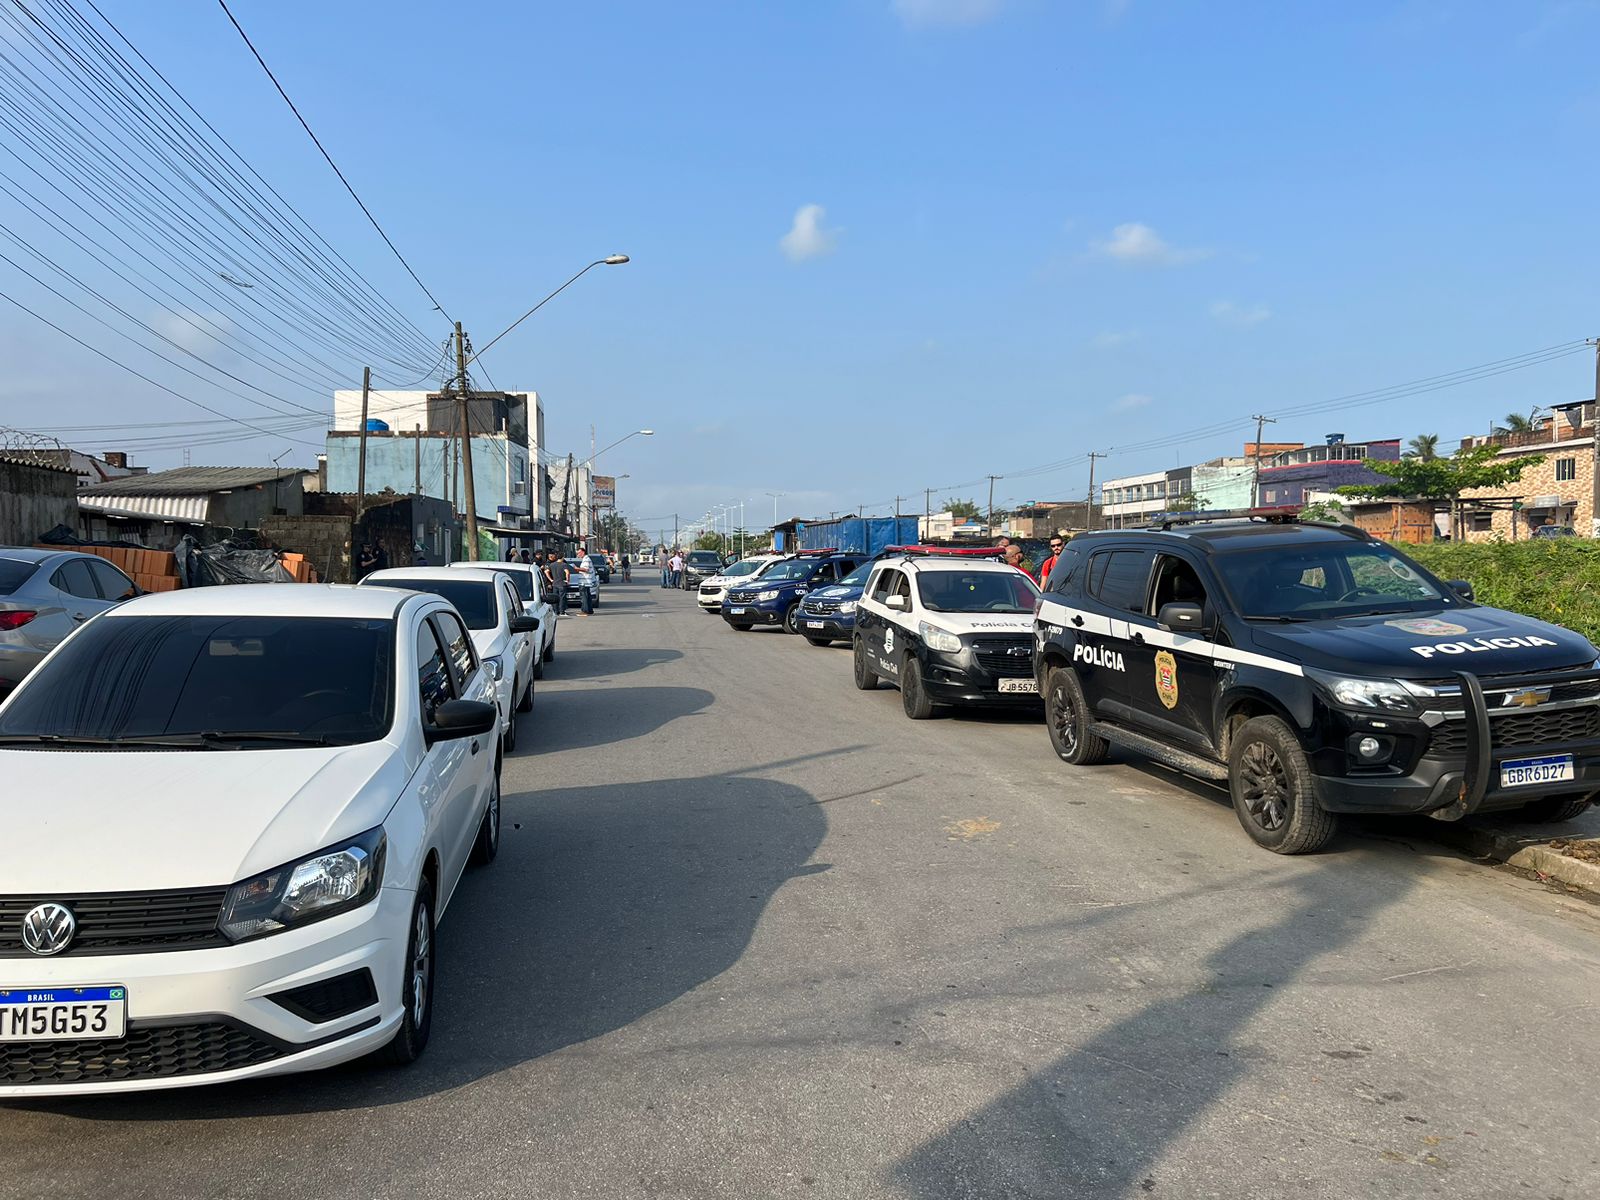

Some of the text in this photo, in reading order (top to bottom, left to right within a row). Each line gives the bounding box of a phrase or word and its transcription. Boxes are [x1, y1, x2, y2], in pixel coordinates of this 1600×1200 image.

[1073, 643, 1126, 673] POLÍCIA
[1410, 635, 1558, 659] POLÍCIA
[1507, 763, 1566, 784] GBR6D27
[27, 993, 55, 1002] BRASIL
